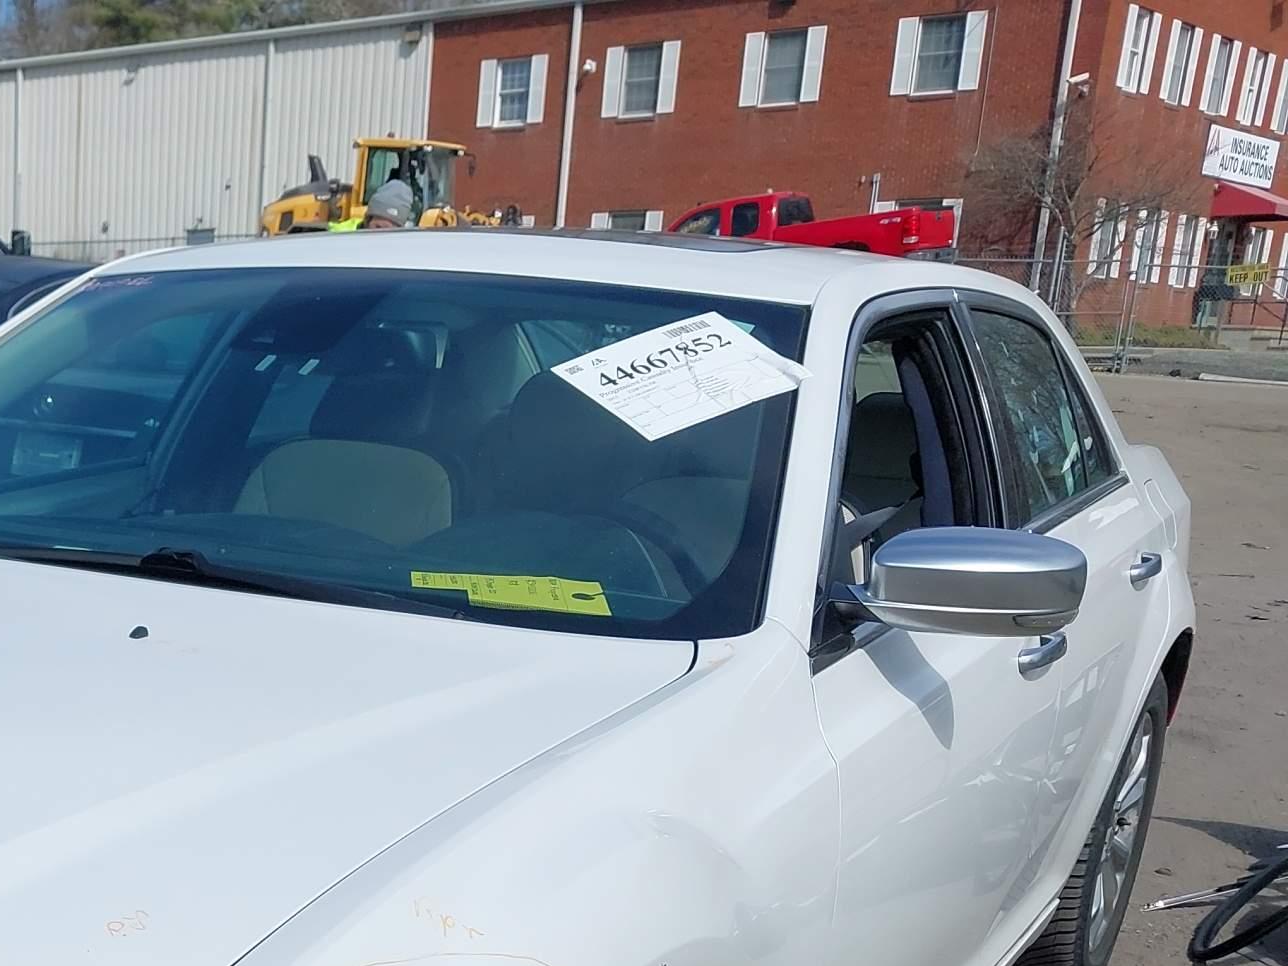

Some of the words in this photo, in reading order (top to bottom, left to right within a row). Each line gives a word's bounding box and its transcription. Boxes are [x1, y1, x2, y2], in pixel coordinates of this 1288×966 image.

[1231, 137, 1270, 161] INSURANCE
[1219, 154, 1239, 173] AUTO
[1239, 159, 1273, 180] AUCTIONS
[1229, 274, 1249, 283] KEEP
[1253, 271, 1268, 282] OUT
[600, 333, 732, 387] 44667852
